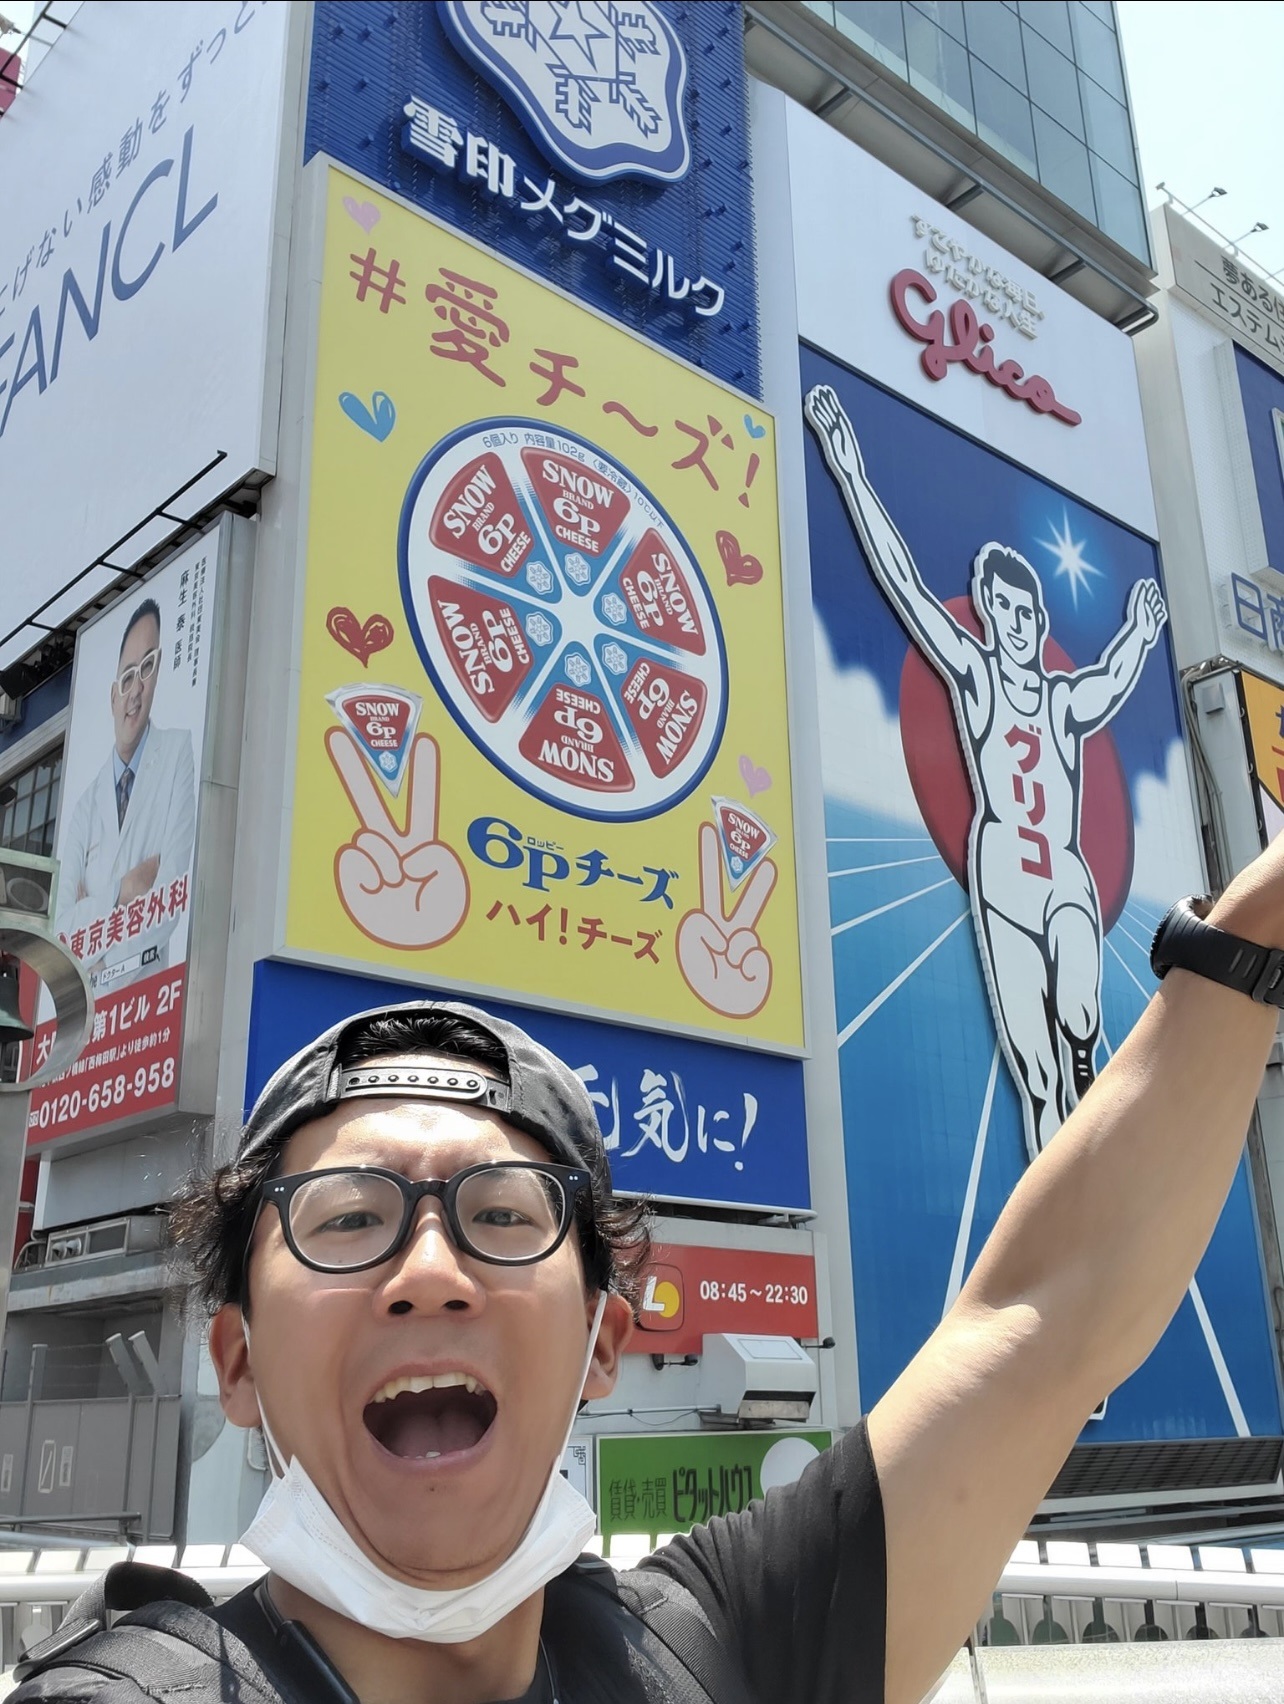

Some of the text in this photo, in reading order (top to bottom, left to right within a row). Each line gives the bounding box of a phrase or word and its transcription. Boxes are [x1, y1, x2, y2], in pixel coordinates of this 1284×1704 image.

[0, 0, 267, 316] げない感動をずっと
[403, 94, 726, 317] 雪印メグミルク
[924, 249, 1038, 341] ゆたかな人生
[1210, 282, 1284, 357] エステム
[890, 268, 1083, 427] Glico
[443, 464, 497, 539] SNOW
[542, 459, 614, 508] SNOW
[562, 489, 594, 510] BRAND
[471, 501, 495, 531] BRAND
[478, 513, 516, 555] 6P
[553, 497, 600, 537] 6P
[500, 531, 531, 572] CHEESE
[555, 524, 599, 553] CHEESE
[623, 577, 650, 629] CHEESE
[637, 570, 664, 626] 6P
[651, 552, 699, 635] SNOW
[654, 578, 673, 615] BRAND
[437, 599, 495, 695] SNOW
[470, 622, 492, 665] BRAND
[482, 610, 513, 673] 6P
[499, 607, 530, 664] CHEESE
[556, 688, 601, 715] CHEESE
[623, 662, 651, 704] CHEESE
[637, 678, 670, 720] 6P
[355, 702, 400, 716] SNOW
[366, 721, 397, 739] 6P
[554, 705, 603, 744] 6P
[656, 698, 675, 729] BRAND
[656, 689, 698, 765] SNOW
[370, 739, 398, 748] CHEESE
[538, 739, 614, 783] SNOW
[561, 734, 594, 753] BRAND
[1003, 723, 1053, 881] グリコ
[727, 812, 760, 839] SNOW
[730, 830, 751, 851] 6P
[70, 874, 188, 960] 東京美容外科
[156, 980, 182, 1016] 2F
[38, 1057, 175, 1129] 0120-658-958
